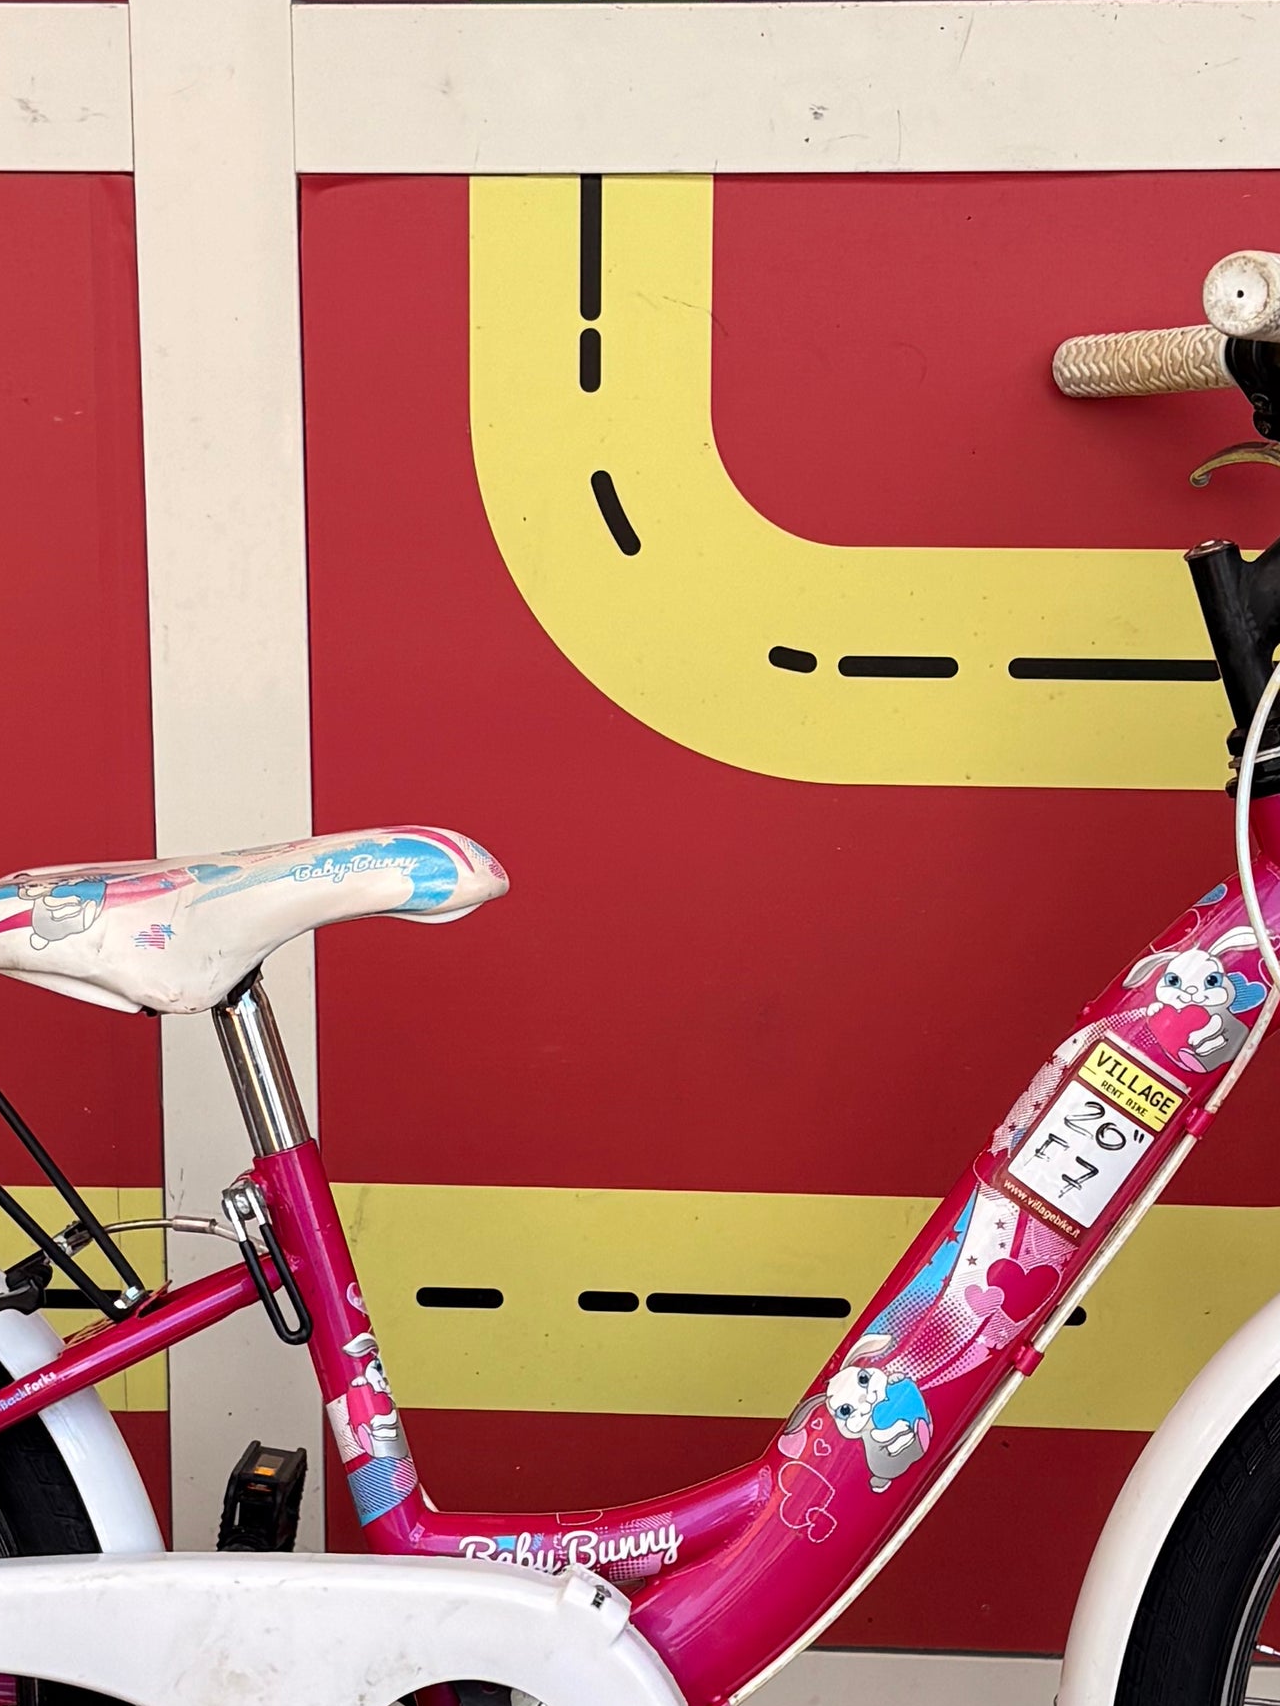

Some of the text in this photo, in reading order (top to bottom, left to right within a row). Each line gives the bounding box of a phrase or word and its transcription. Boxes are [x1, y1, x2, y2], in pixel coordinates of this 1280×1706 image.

[291, 854, 419, 883] Baby Bunny
[1096, 1050, 1176, 1115] VILLAGE
[1101, 1080, 1149, 1118] RENT BIKE
[1064, 1101, 1145, 1151] 20"
[1003, 1180, 1081, 1239] www.villagebike.it
[561, 1523, 684, 1569] Bunny
